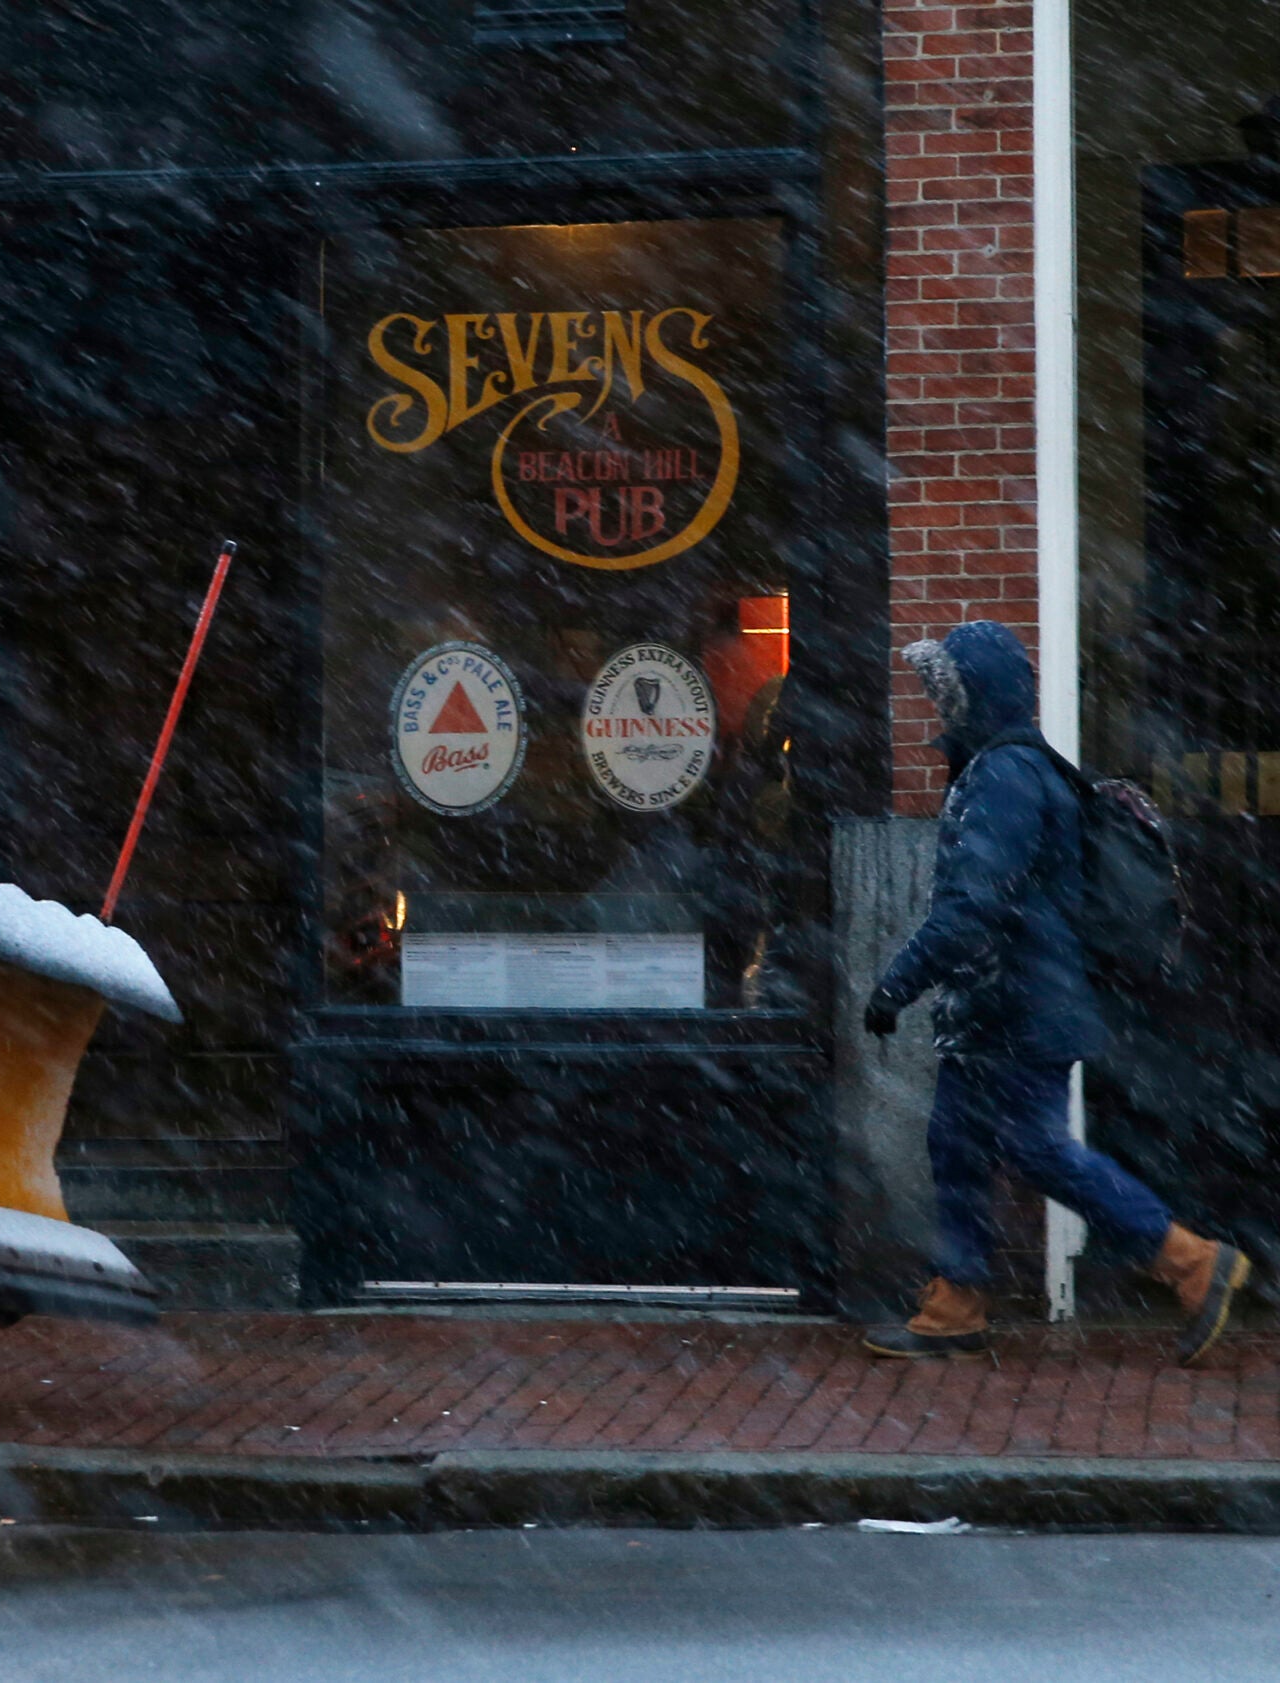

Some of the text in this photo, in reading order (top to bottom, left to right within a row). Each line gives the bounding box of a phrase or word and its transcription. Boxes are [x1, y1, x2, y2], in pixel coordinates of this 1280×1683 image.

[366, 306, 740, 571] SEVENS
[601, 410, 624, 441] A
[518, 448, 706, 482] BEACON HILL
[554, 485, 666, 547] PUB
[403, 688, 427, 733] BASS
[421, 670, 439, 686] &
[461, 656, 504, 694] PALE
[493, 699, 513, 732] ALE
[588, 648, 710, 715] GUINNESS EXTRA STOUT
[585, 717, 712, 739] GUINNESS
[422, 742, 489, 774] Bass
[591, 750, 645, 805] BREWERS
[649, 777, 690, 806] SINCE
